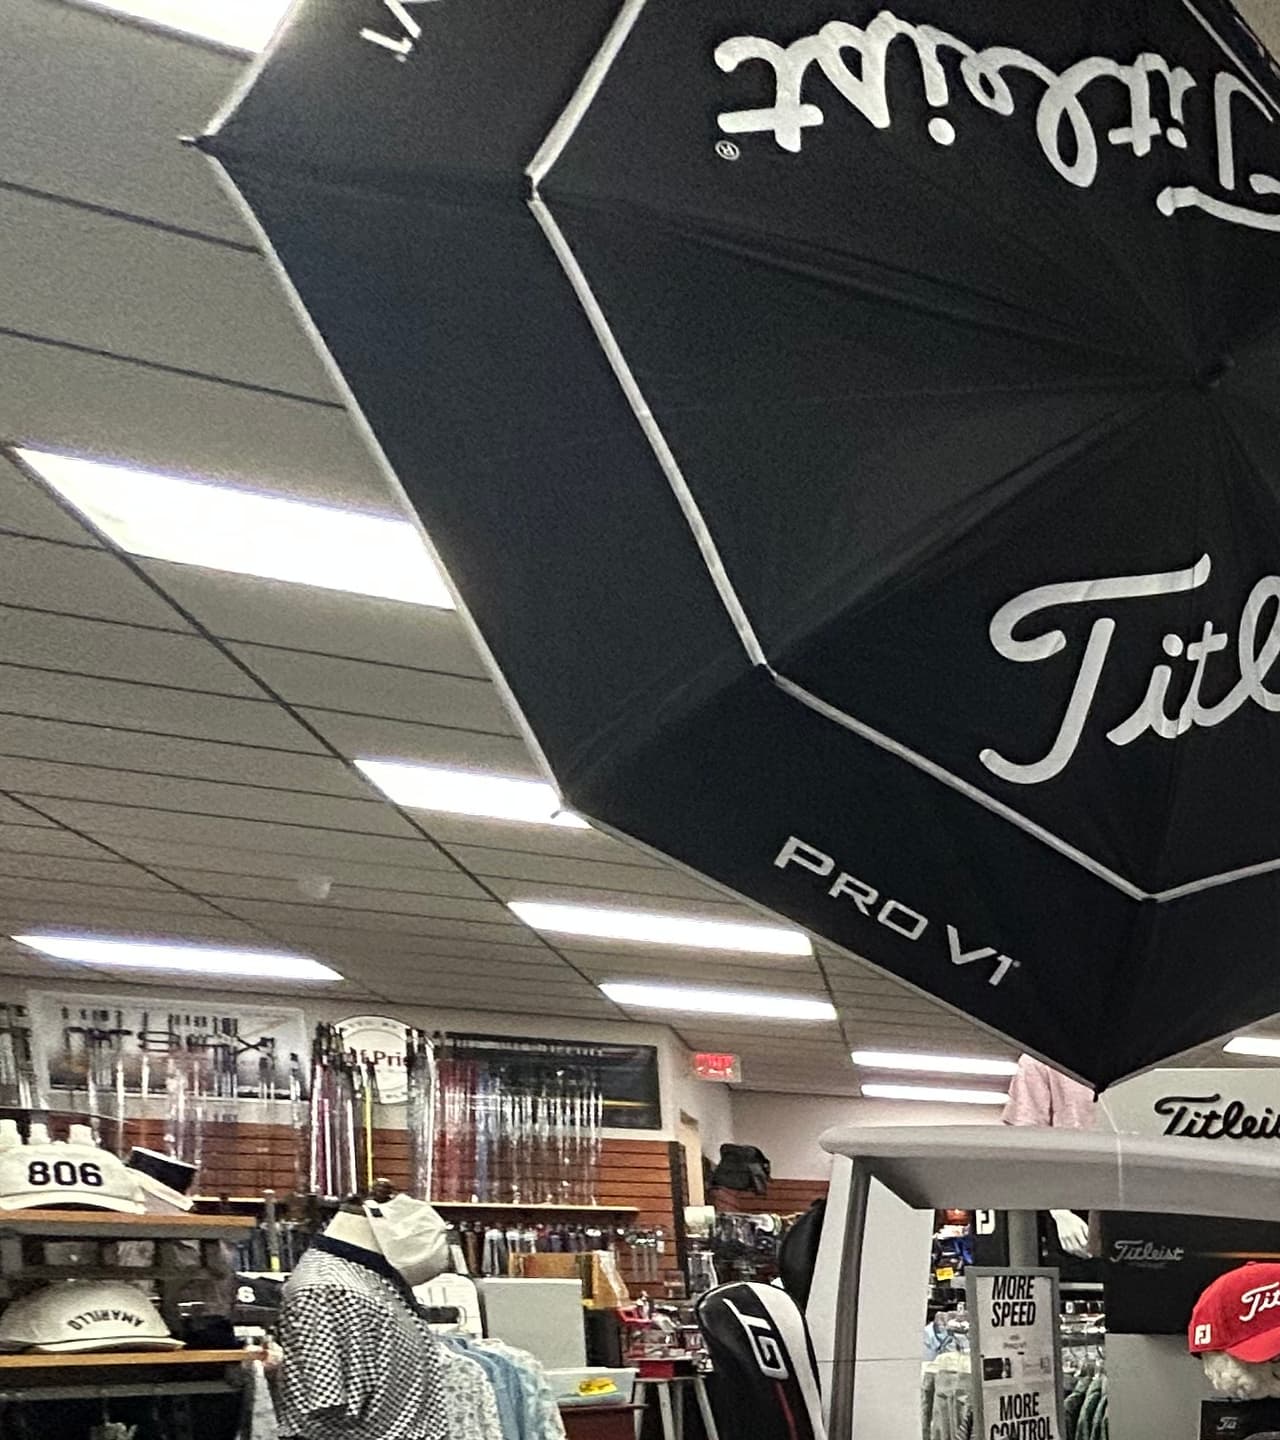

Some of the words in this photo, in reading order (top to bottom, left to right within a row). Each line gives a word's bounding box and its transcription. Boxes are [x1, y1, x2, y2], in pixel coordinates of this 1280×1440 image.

[773, 836, 930, 943] PRO
[946, 923, 1017, 988] V1
[28, 1160, 104, 1188] 806
[1109, 1239, 1185, 1263] Titleist
[992, 1275, 1036, 1301] MORE
[66, 1308, 145, 1332] AMARILLO
[991, 1301, 1037, 1328] SPEED
[999, 1391, 1041, 1422] MORE
